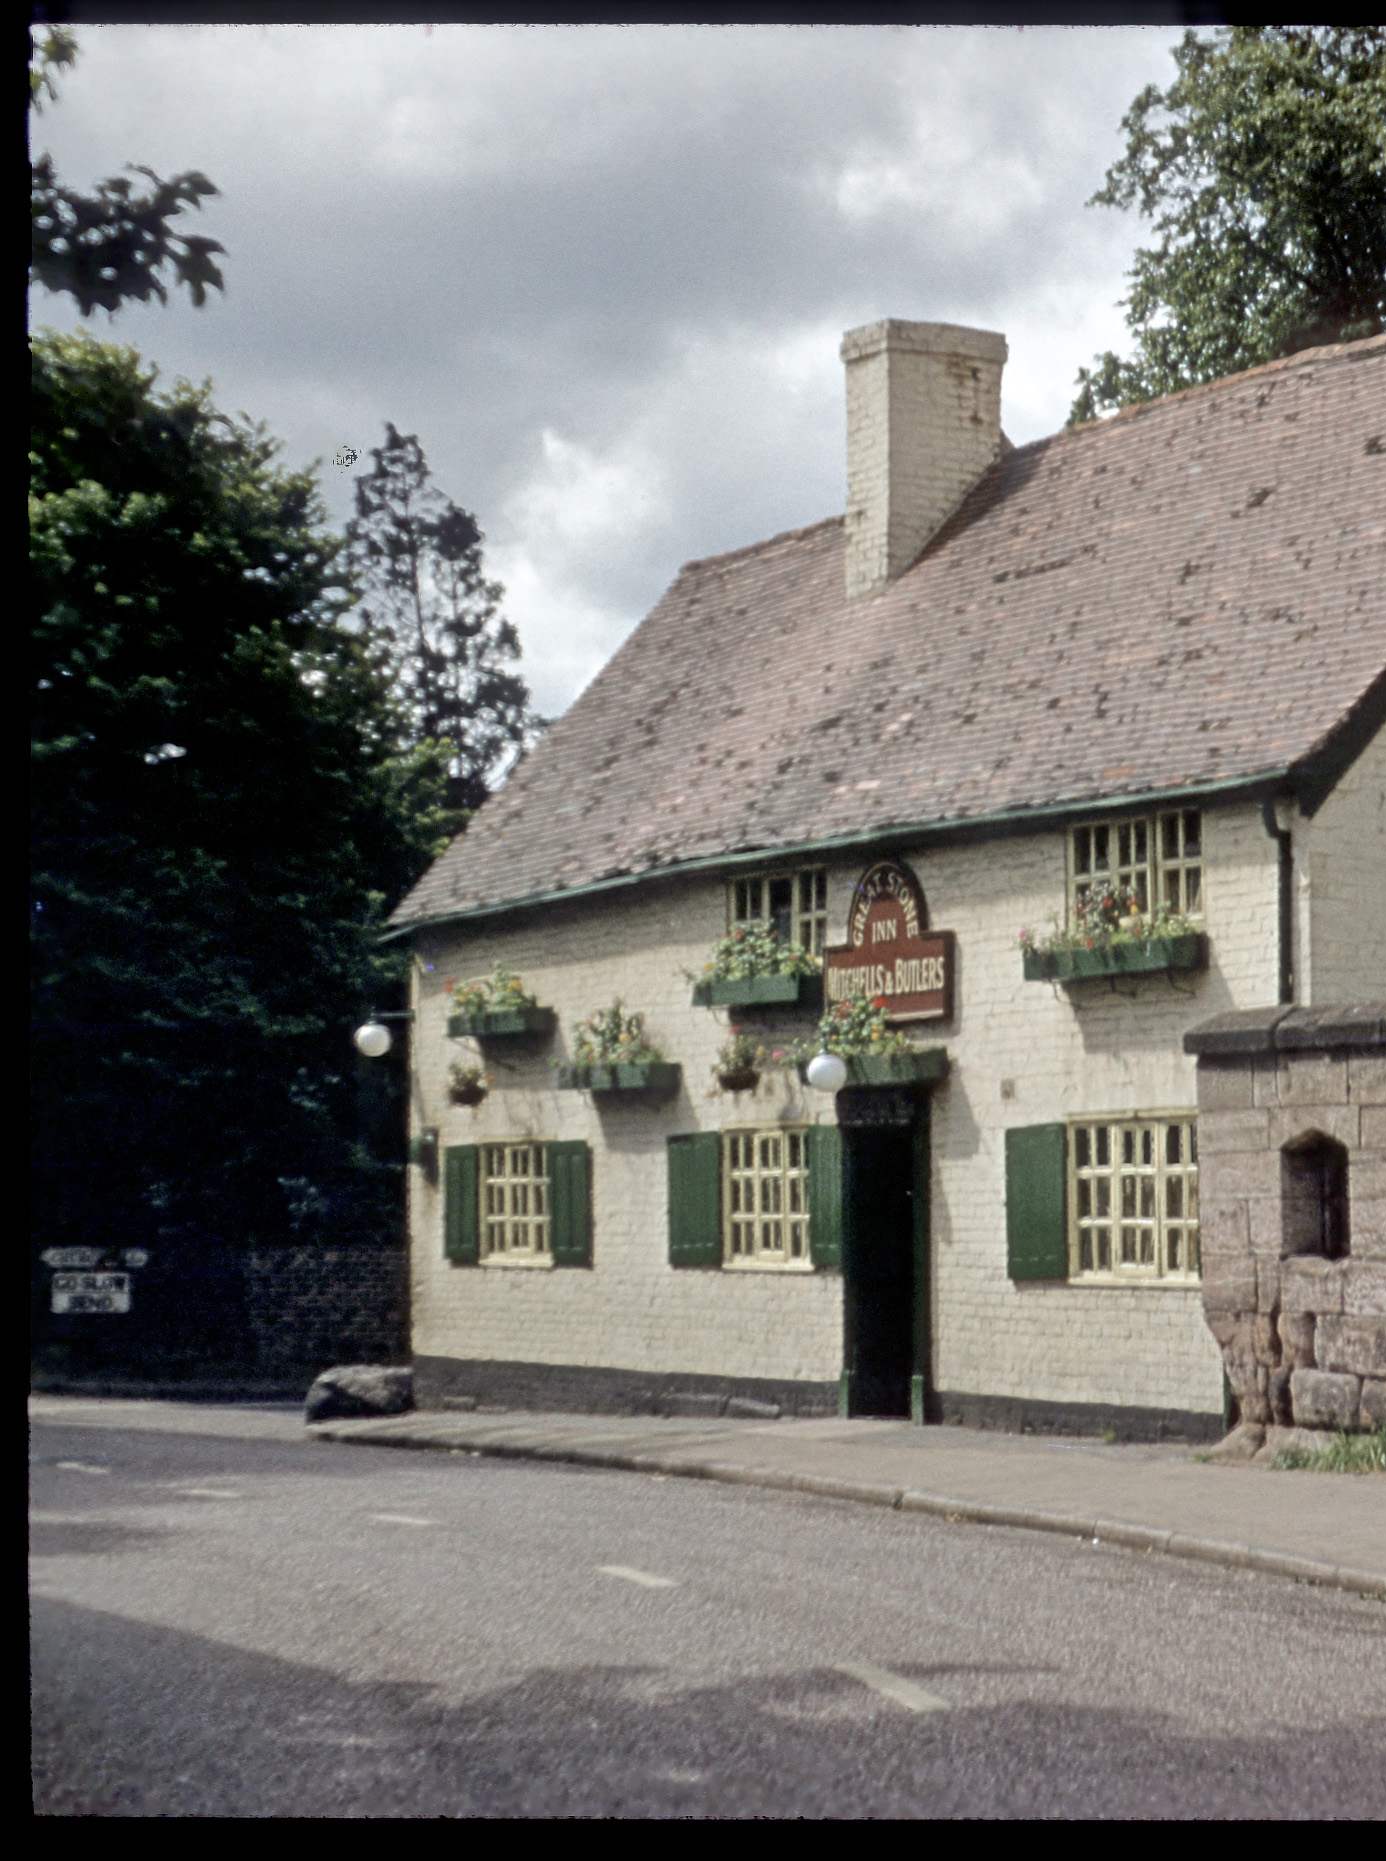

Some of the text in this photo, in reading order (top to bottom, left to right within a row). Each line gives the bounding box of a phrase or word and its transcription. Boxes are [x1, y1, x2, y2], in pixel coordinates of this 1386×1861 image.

[853, 872, 919, 947] GREAT STONE
[872, 919, 897, 944] INN
[884, 970, 894, 996] &
[895, 956, 945, 995] BUTLERS
